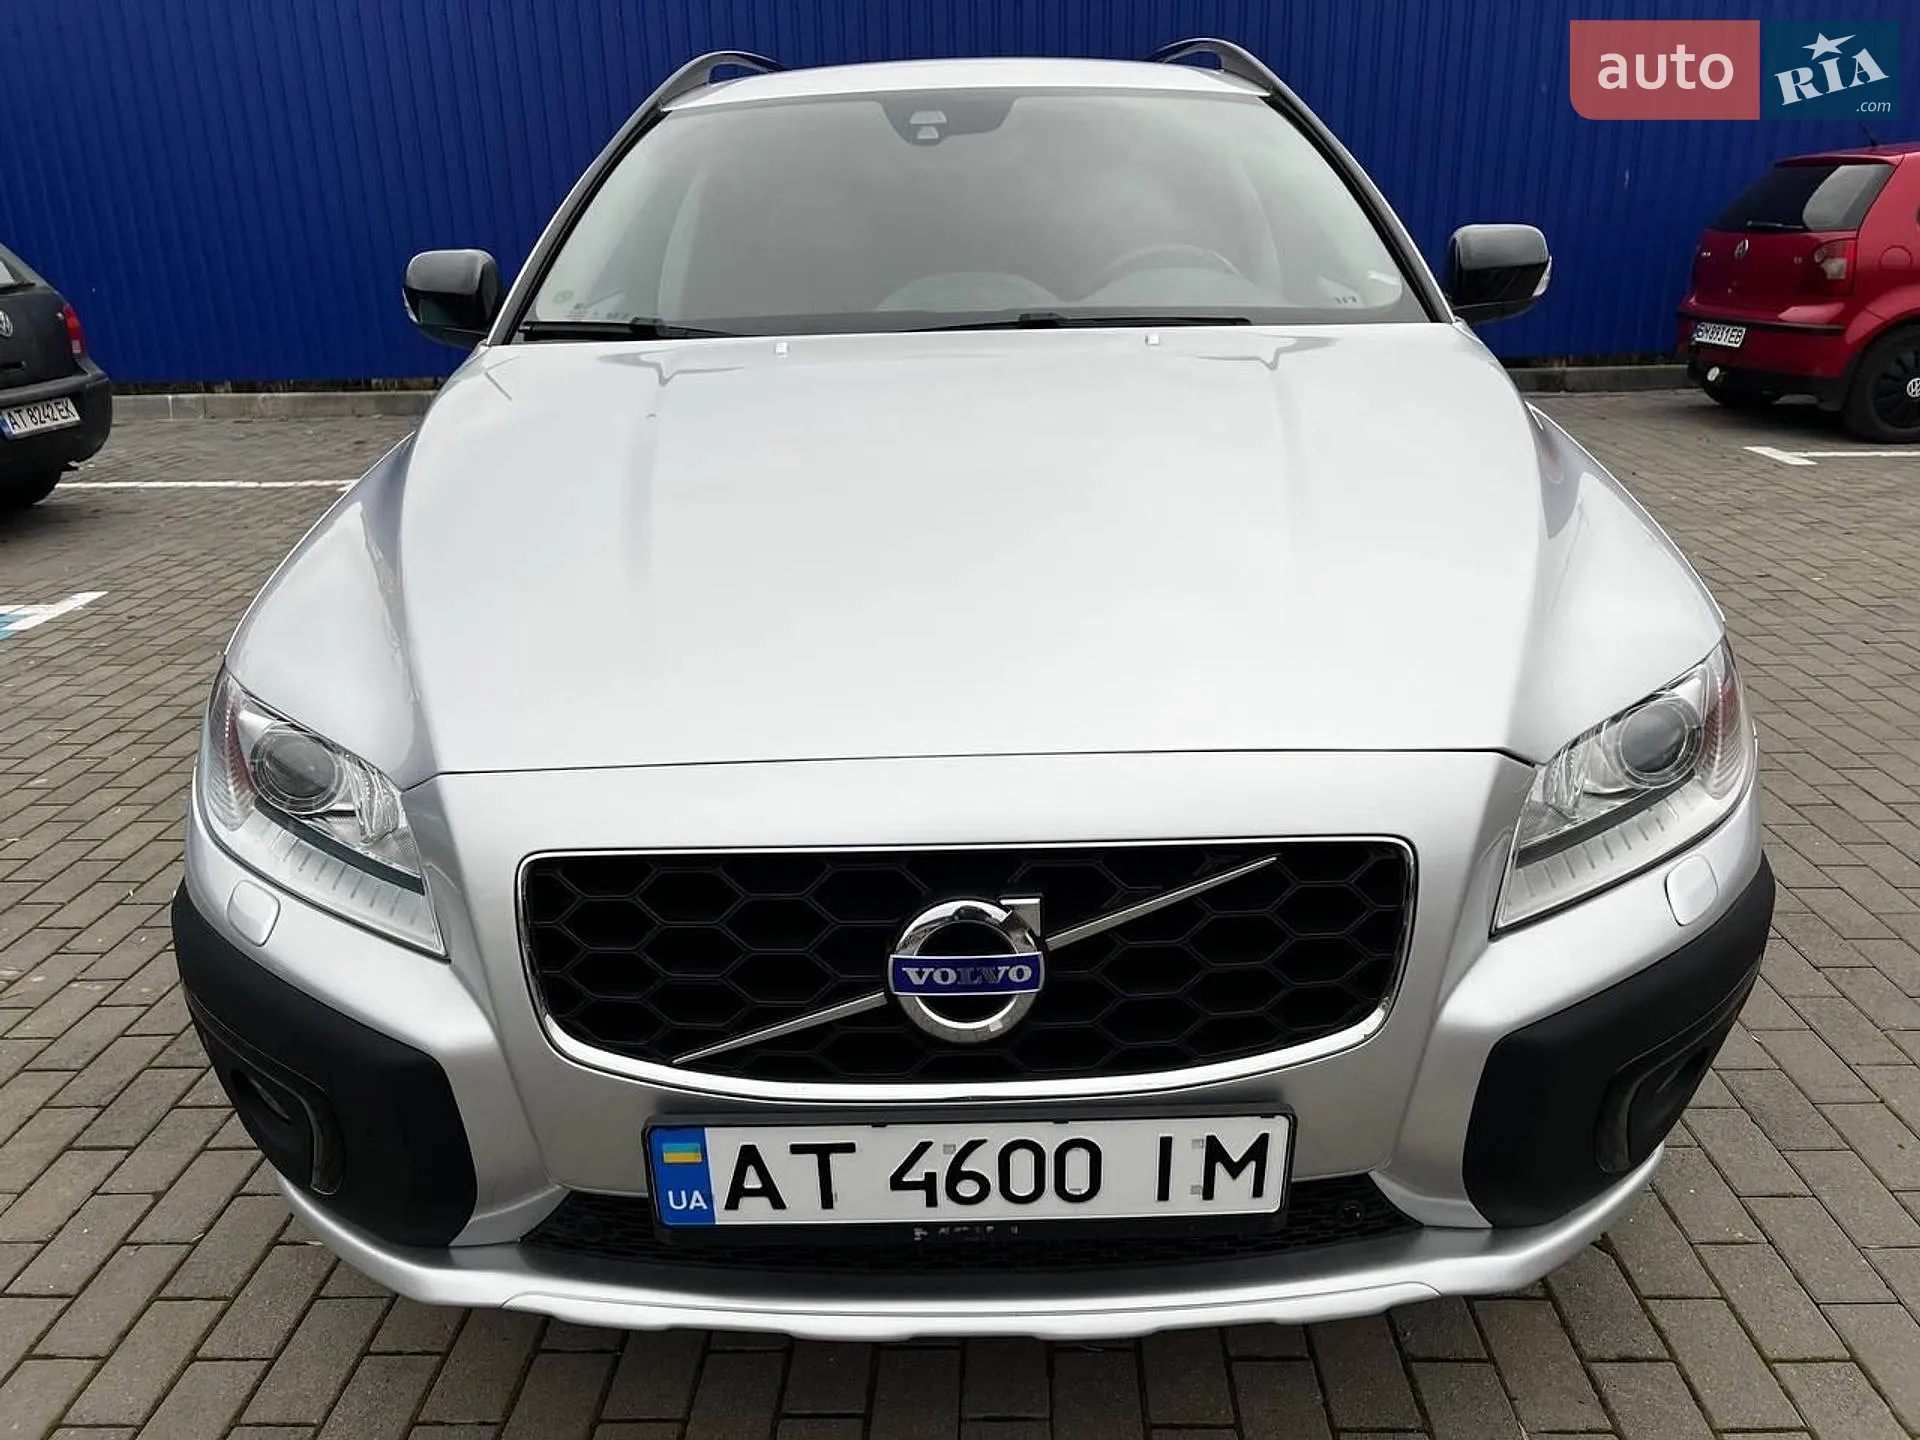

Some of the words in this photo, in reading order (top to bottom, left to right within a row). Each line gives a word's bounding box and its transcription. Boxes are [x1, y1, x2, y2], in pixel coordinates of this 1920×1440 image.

[8, 410, 27, 430] AT
[27, 402, 58, 425] 8242
[55, 400, 75, 419] EK
[902, 964, 1032, 985] VOLVO
[724, 1142, 856, 1210] AT
[889, 1137, 1103, 1208] 4600
[1157, 1132, 1270, 1202] IM
[668, 1190, 708, 1212] UA
